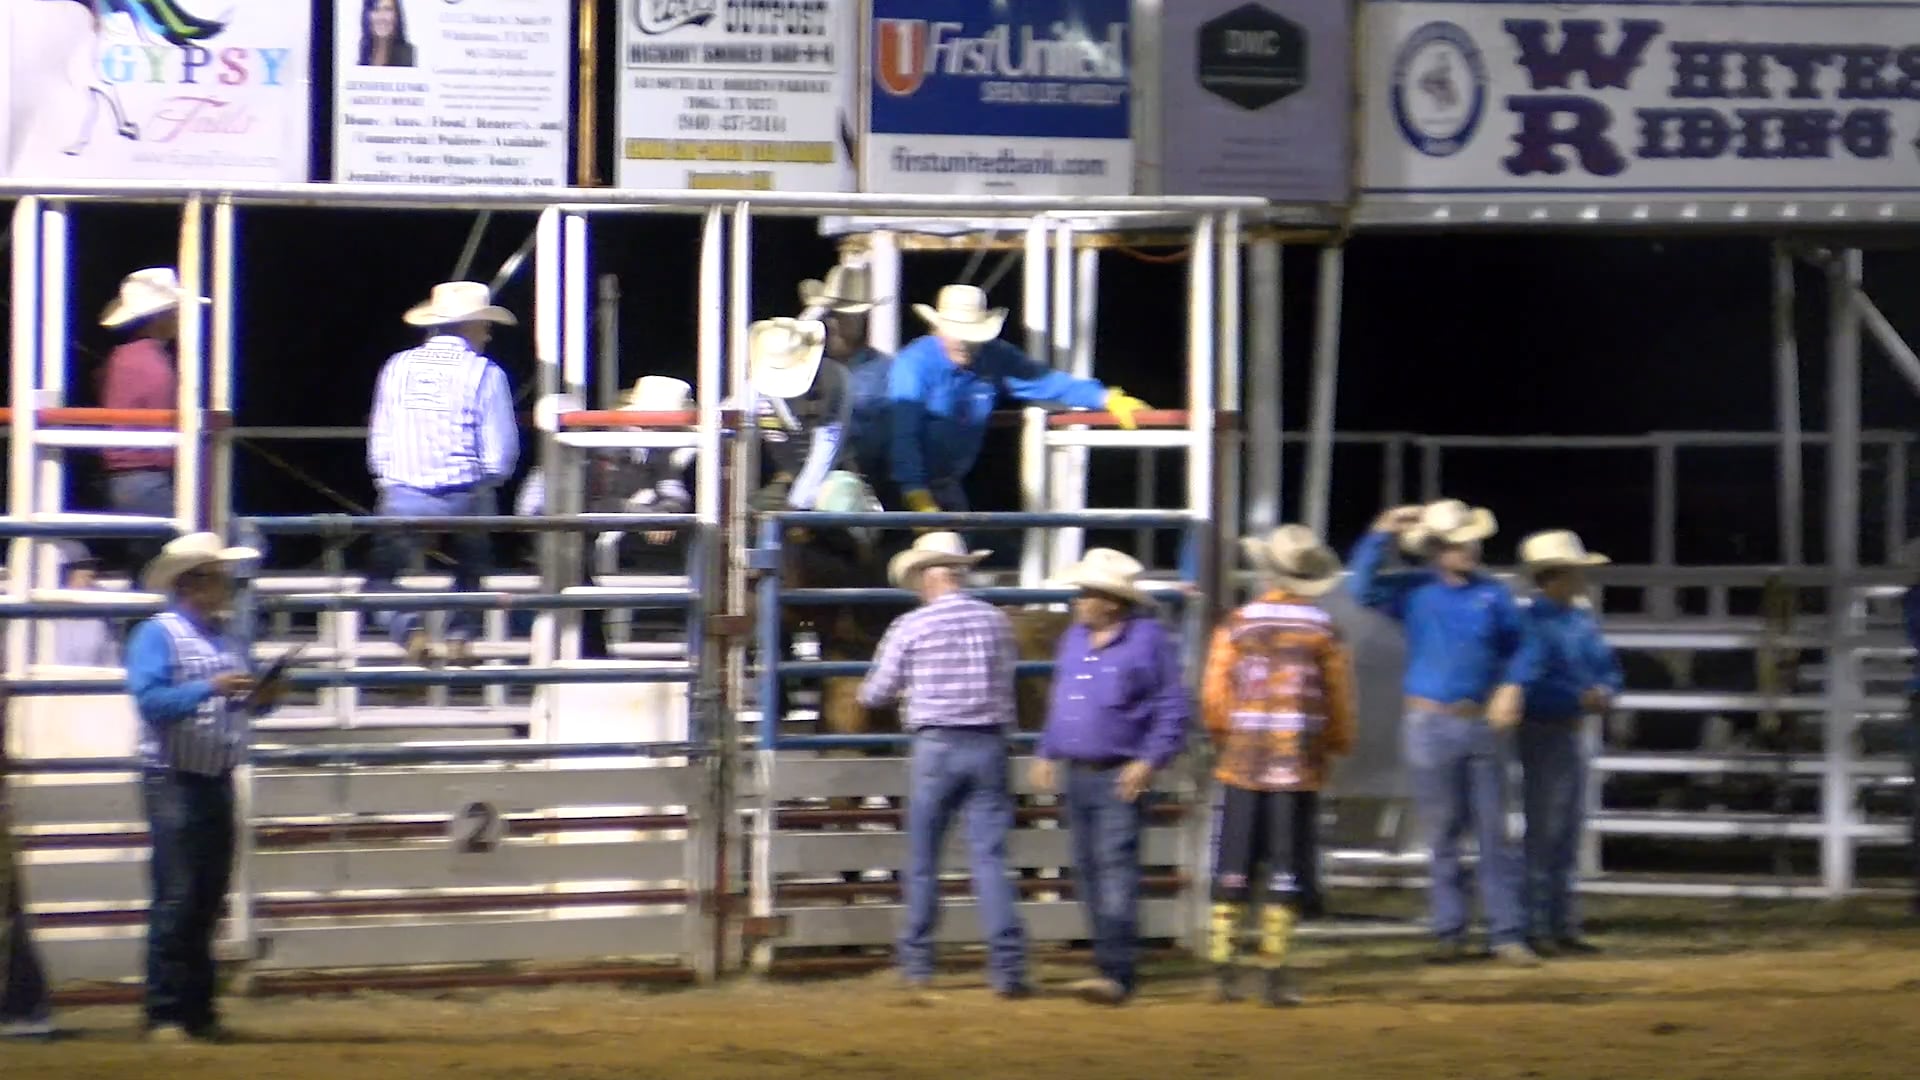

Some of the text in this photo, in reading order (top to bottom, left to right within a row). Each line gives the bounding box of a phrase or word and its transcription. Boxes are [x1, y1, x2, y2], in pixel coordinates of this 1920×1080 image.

[102, 44, 290, 86] GYPSY
[1503, 94, 1893, 177] RIDING
[461, 801, 497, 853] 2
